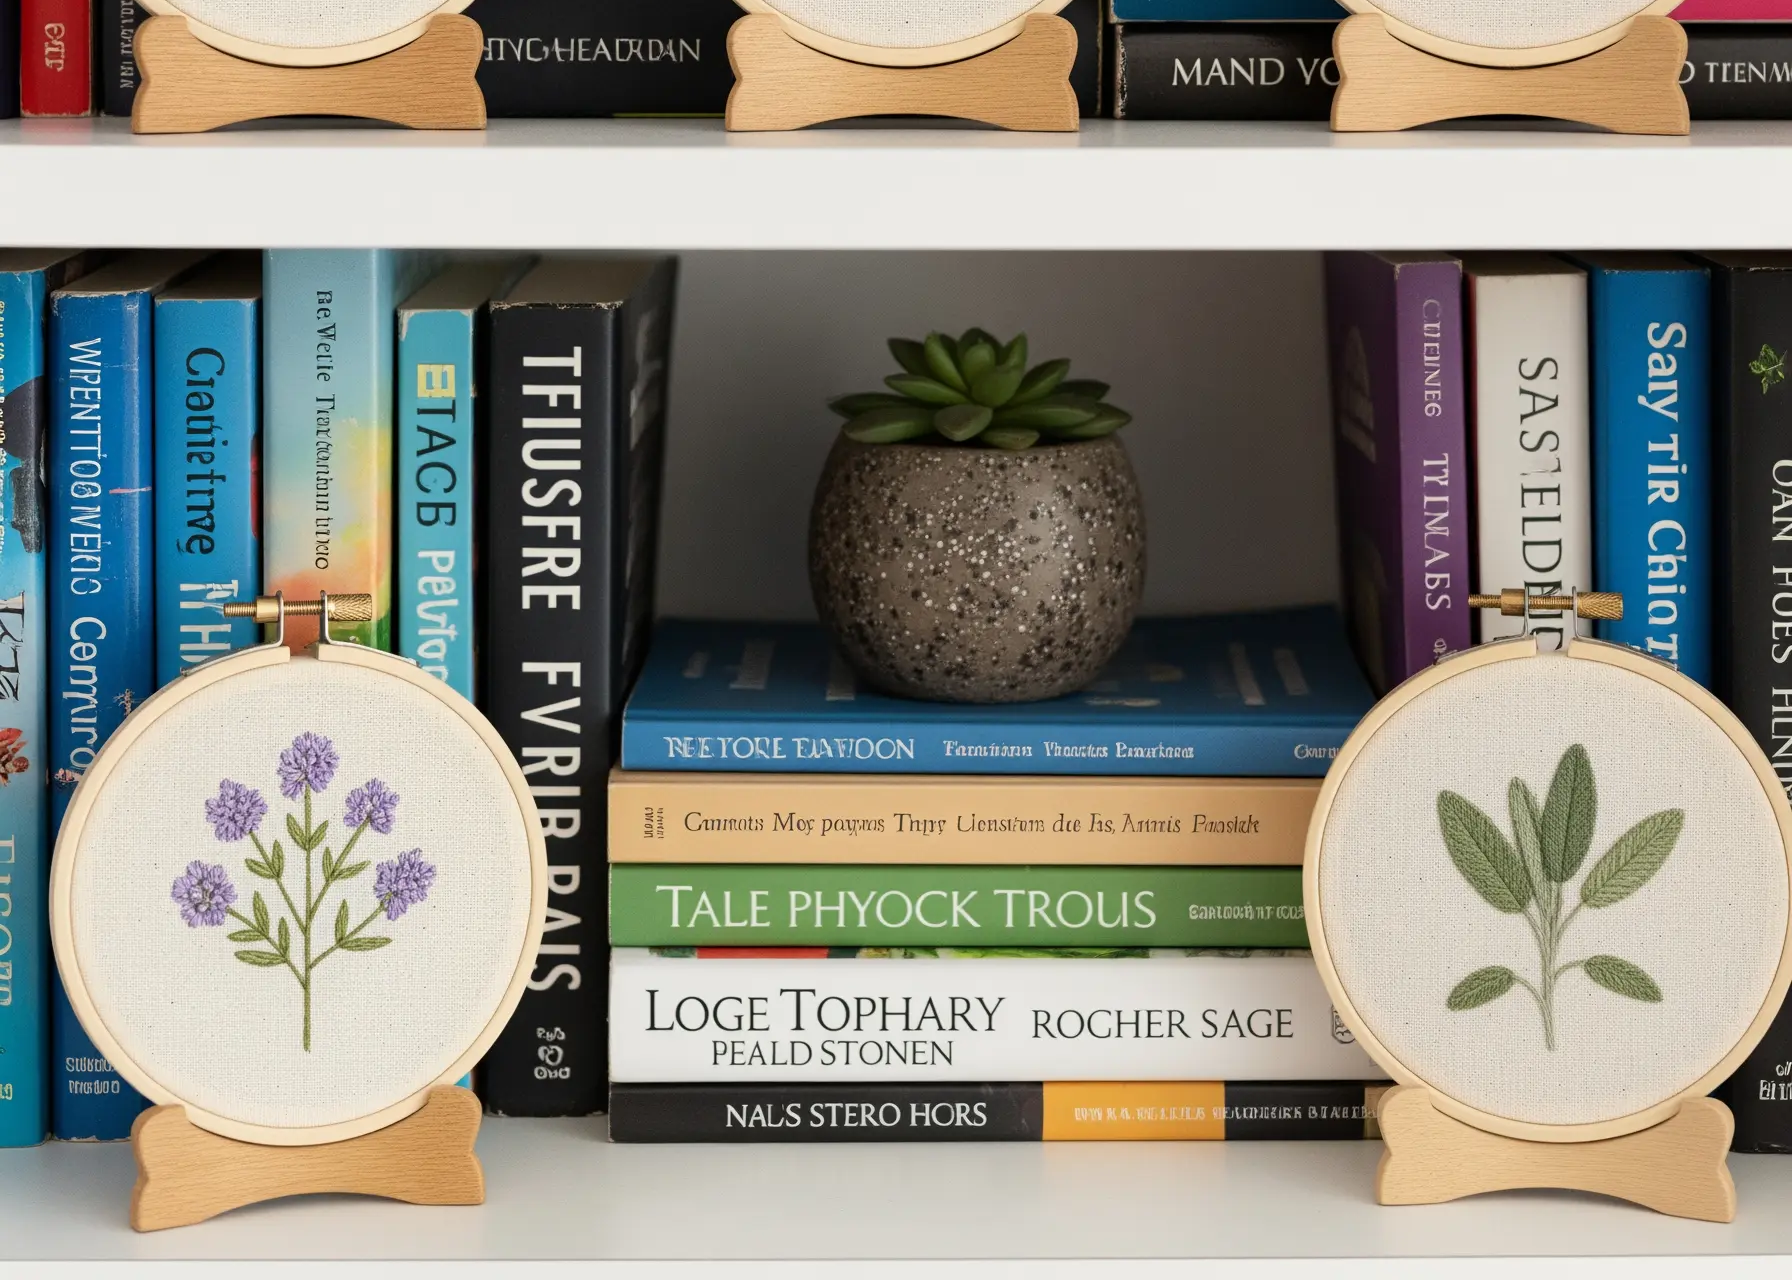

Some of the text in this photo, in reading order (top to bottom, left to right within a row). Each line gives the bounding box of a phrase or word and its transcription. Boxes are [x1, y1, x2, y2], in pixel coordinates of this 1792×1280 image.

[1172, 57, 1285, 86] MAND
[521, 346, 582, 610] TFIUSFRE
[655, 884, 770, 928] TALE
[788, 890, 981, 928] PHYOCK
[993, 889, 1157, 929] TROUS
[645, 988, 1294, 1039] LOGE TOPHARY ROCHER SAGE
[712, 1040, 954, 1066] PEALD STONEN
[810, 1103, 900, 1127] STERO
[910, 1103, 987, 1127] HORS
